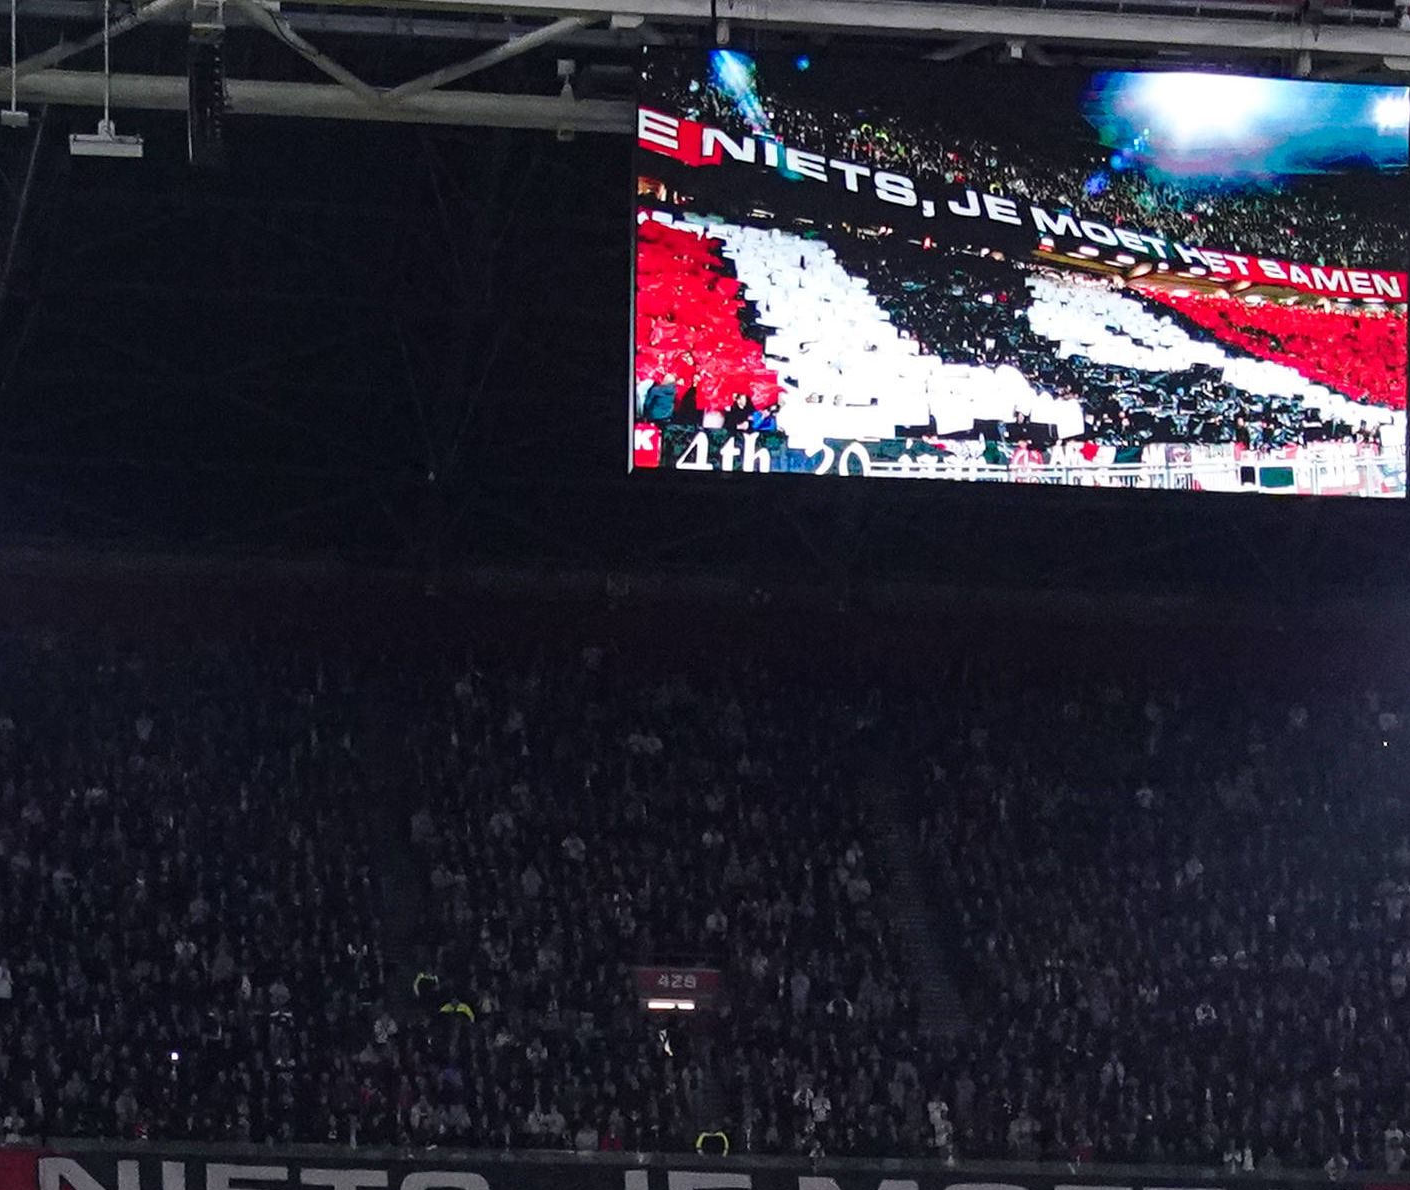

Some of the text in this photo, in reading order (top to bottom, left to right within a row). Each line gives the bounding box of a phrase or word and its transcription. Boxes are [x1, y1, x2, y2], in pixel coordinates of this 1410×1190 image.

[702, 129, 935, 218] NIETS,
[946, 192, 1021, 226] JE
[1031, 206, 1167, 260] MOET
[1180, 244, 1250, 279] HET
[1262, 259, 1403, 300] SAMEN
